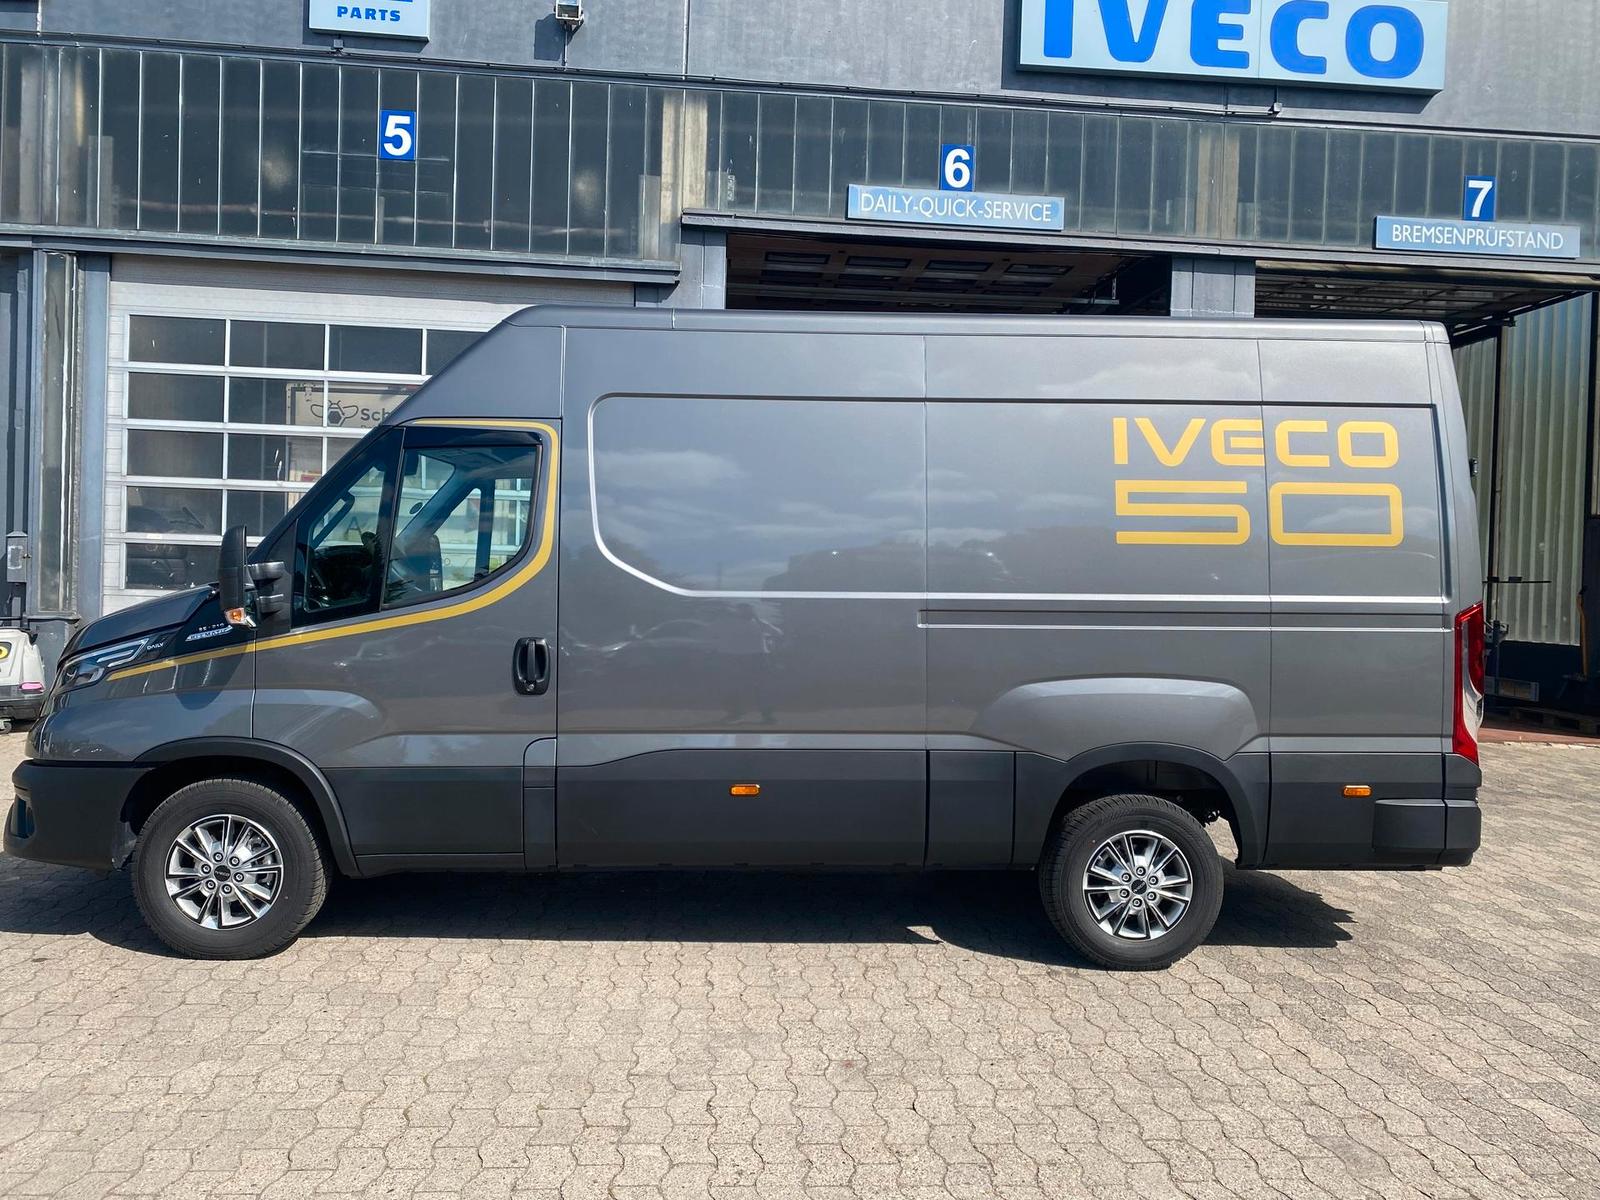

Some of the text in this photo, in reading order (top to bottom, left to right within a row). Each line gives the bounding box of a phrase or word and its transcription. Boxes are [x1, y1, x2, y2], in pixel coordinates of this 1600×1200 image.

[337, 6, 401, 22] PARTS
[1043, 0, 1425, 80] IVECO
[383, 114, 413, 158] 5
[944, 148, 971, 189] 6
[860, 192, 1052, 222] DAILY-QUICK-SERVICE
[1467, 179, 1494, 218] 7
[1391, 225, 1564, 250] BREMSENPRÜFSTAND
[1112, 417, 1400, 469] IVECO
[1115, 479, 1404, 547] 50
[146, 641, 165, 651] DAILY
